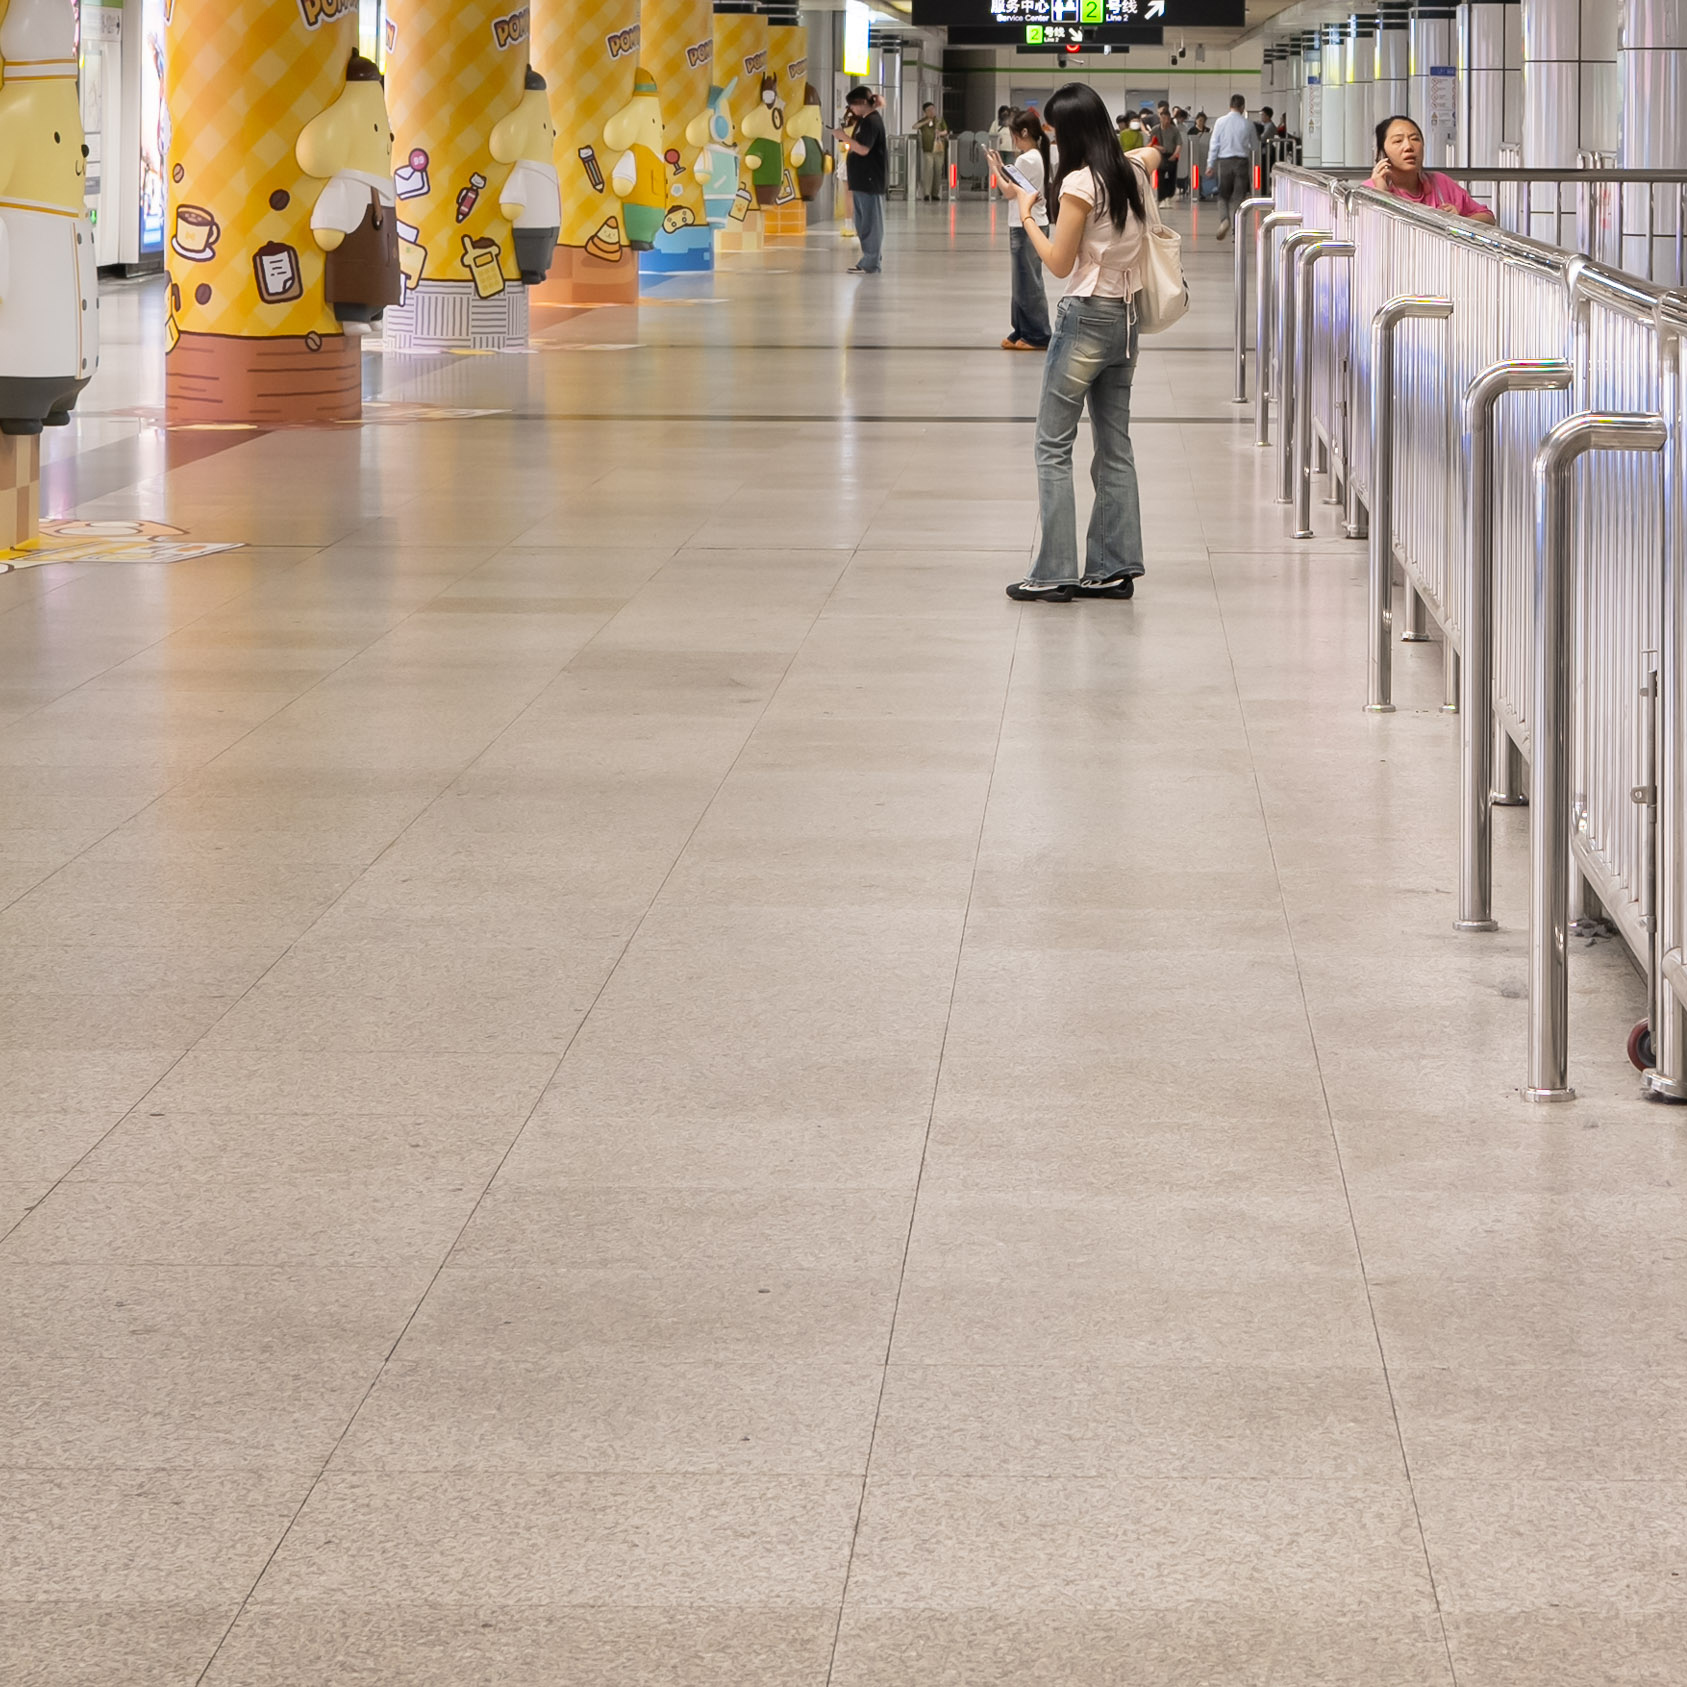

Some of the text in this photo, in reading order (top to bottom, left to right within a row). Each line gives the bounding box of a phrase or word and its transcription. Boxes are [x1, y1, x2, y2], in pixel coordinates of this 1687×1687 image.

[1086, 1, 1097, 18] 2
[996, 14, 1129, 22] Service Center Line 2
[1031, 26, 1065, 41] 2 号线
